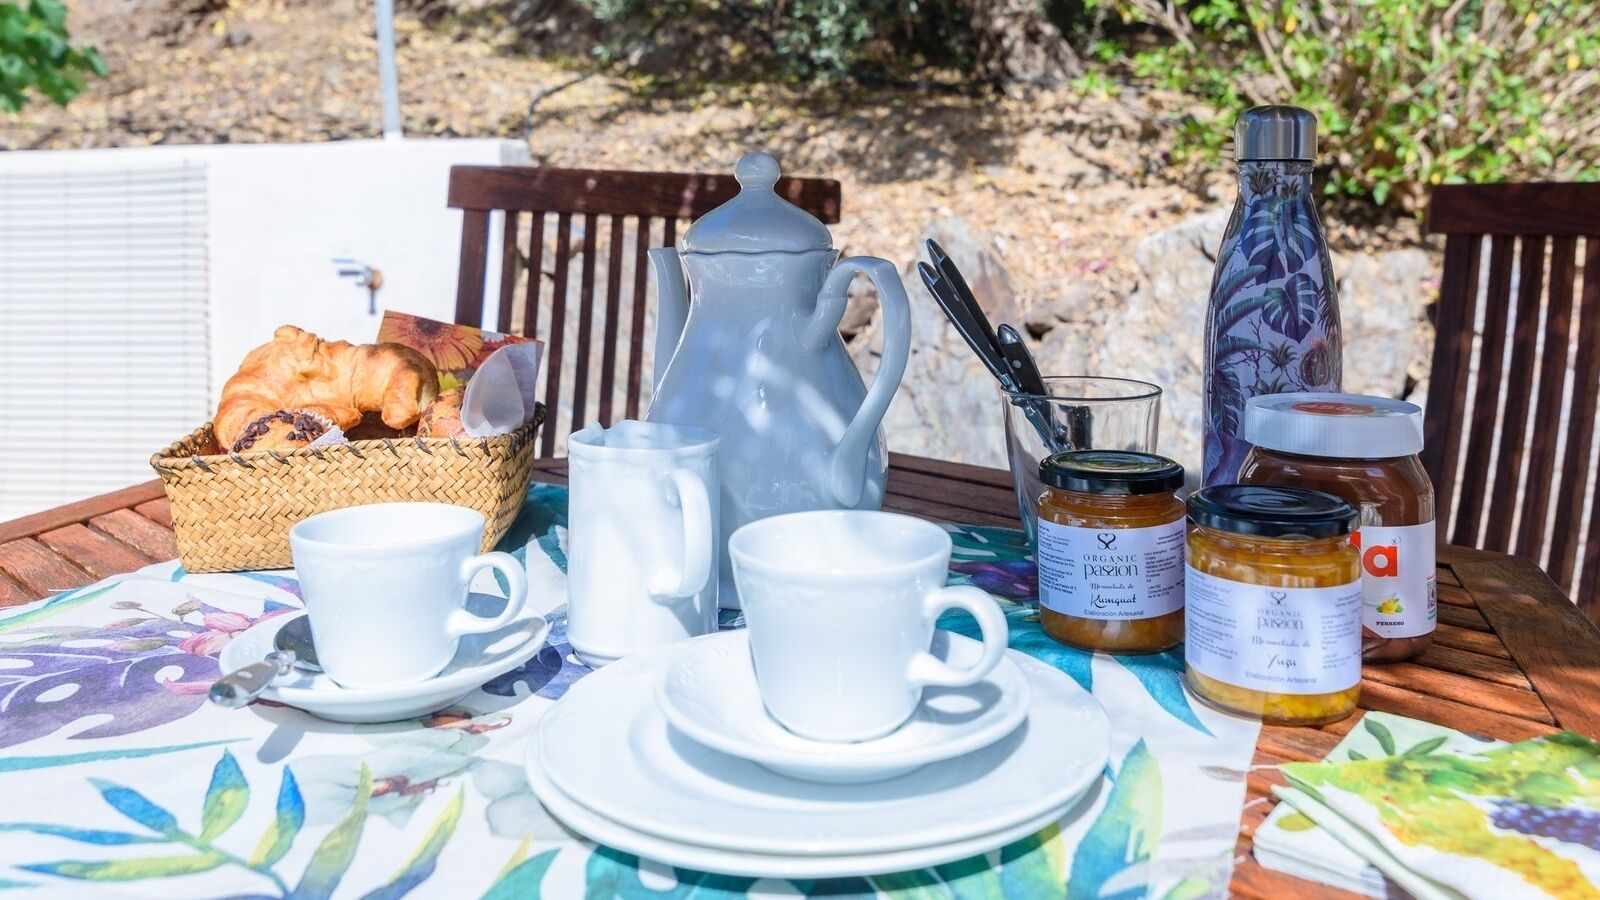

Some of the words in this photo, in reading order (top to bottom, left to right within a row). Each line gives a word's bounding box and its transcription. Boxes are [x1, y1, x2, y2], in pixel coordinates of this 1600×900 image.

[1083, 554, 1137, 563] ORGANIC
[1084, 562, 1139, 580] passion
[1090, 583, 1126, 591] Mermelada
[1090, 593, 1137, 609] Kumquat
[1118, 609, 1144, 617] Artesanal
[1257, 608, 1304, 618] ORGANIC
